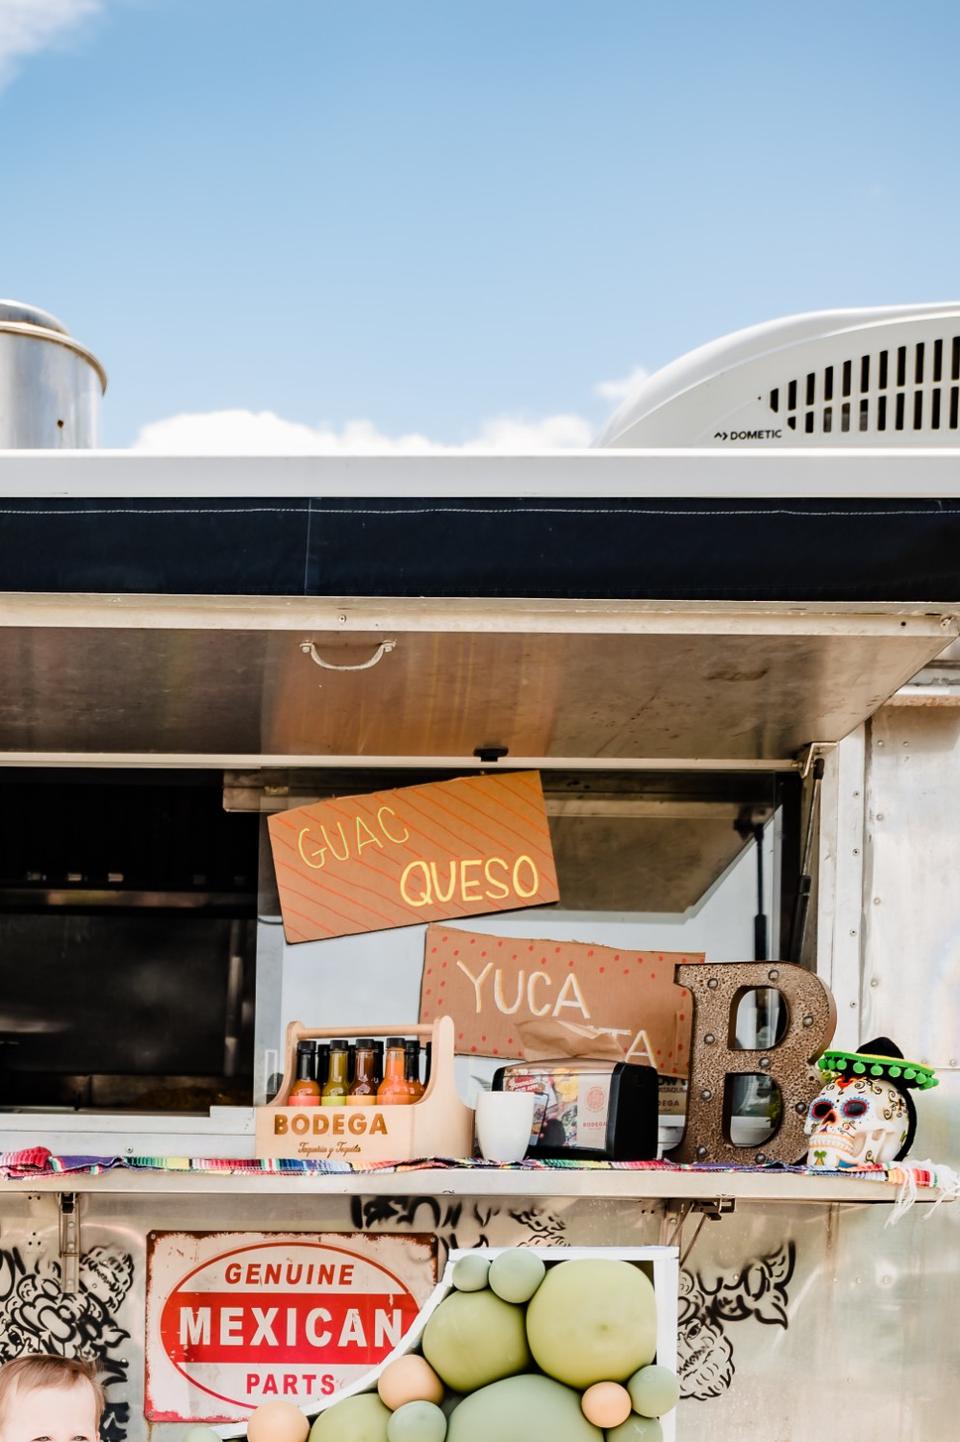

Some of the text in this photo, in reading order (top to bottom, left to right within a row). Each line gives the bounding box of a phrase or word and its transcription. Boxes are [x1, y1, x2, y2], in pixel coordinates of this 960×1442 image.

[730, 430, 782, 440] DOMETIC
[297, 806, 410, 869] GUAC
[400, 855, 539, 907] QUESO
[456, 960, 591, 1019] YUCA
[664, 960, 837, 1164] B
[274, 1113, 388, 1135] BODEGA
[224, 1263, 354, 1285] GENUINE
[179, 1306, 402, 1348] MEXICAN
[246, 1373, 335, 1395] PARTS
